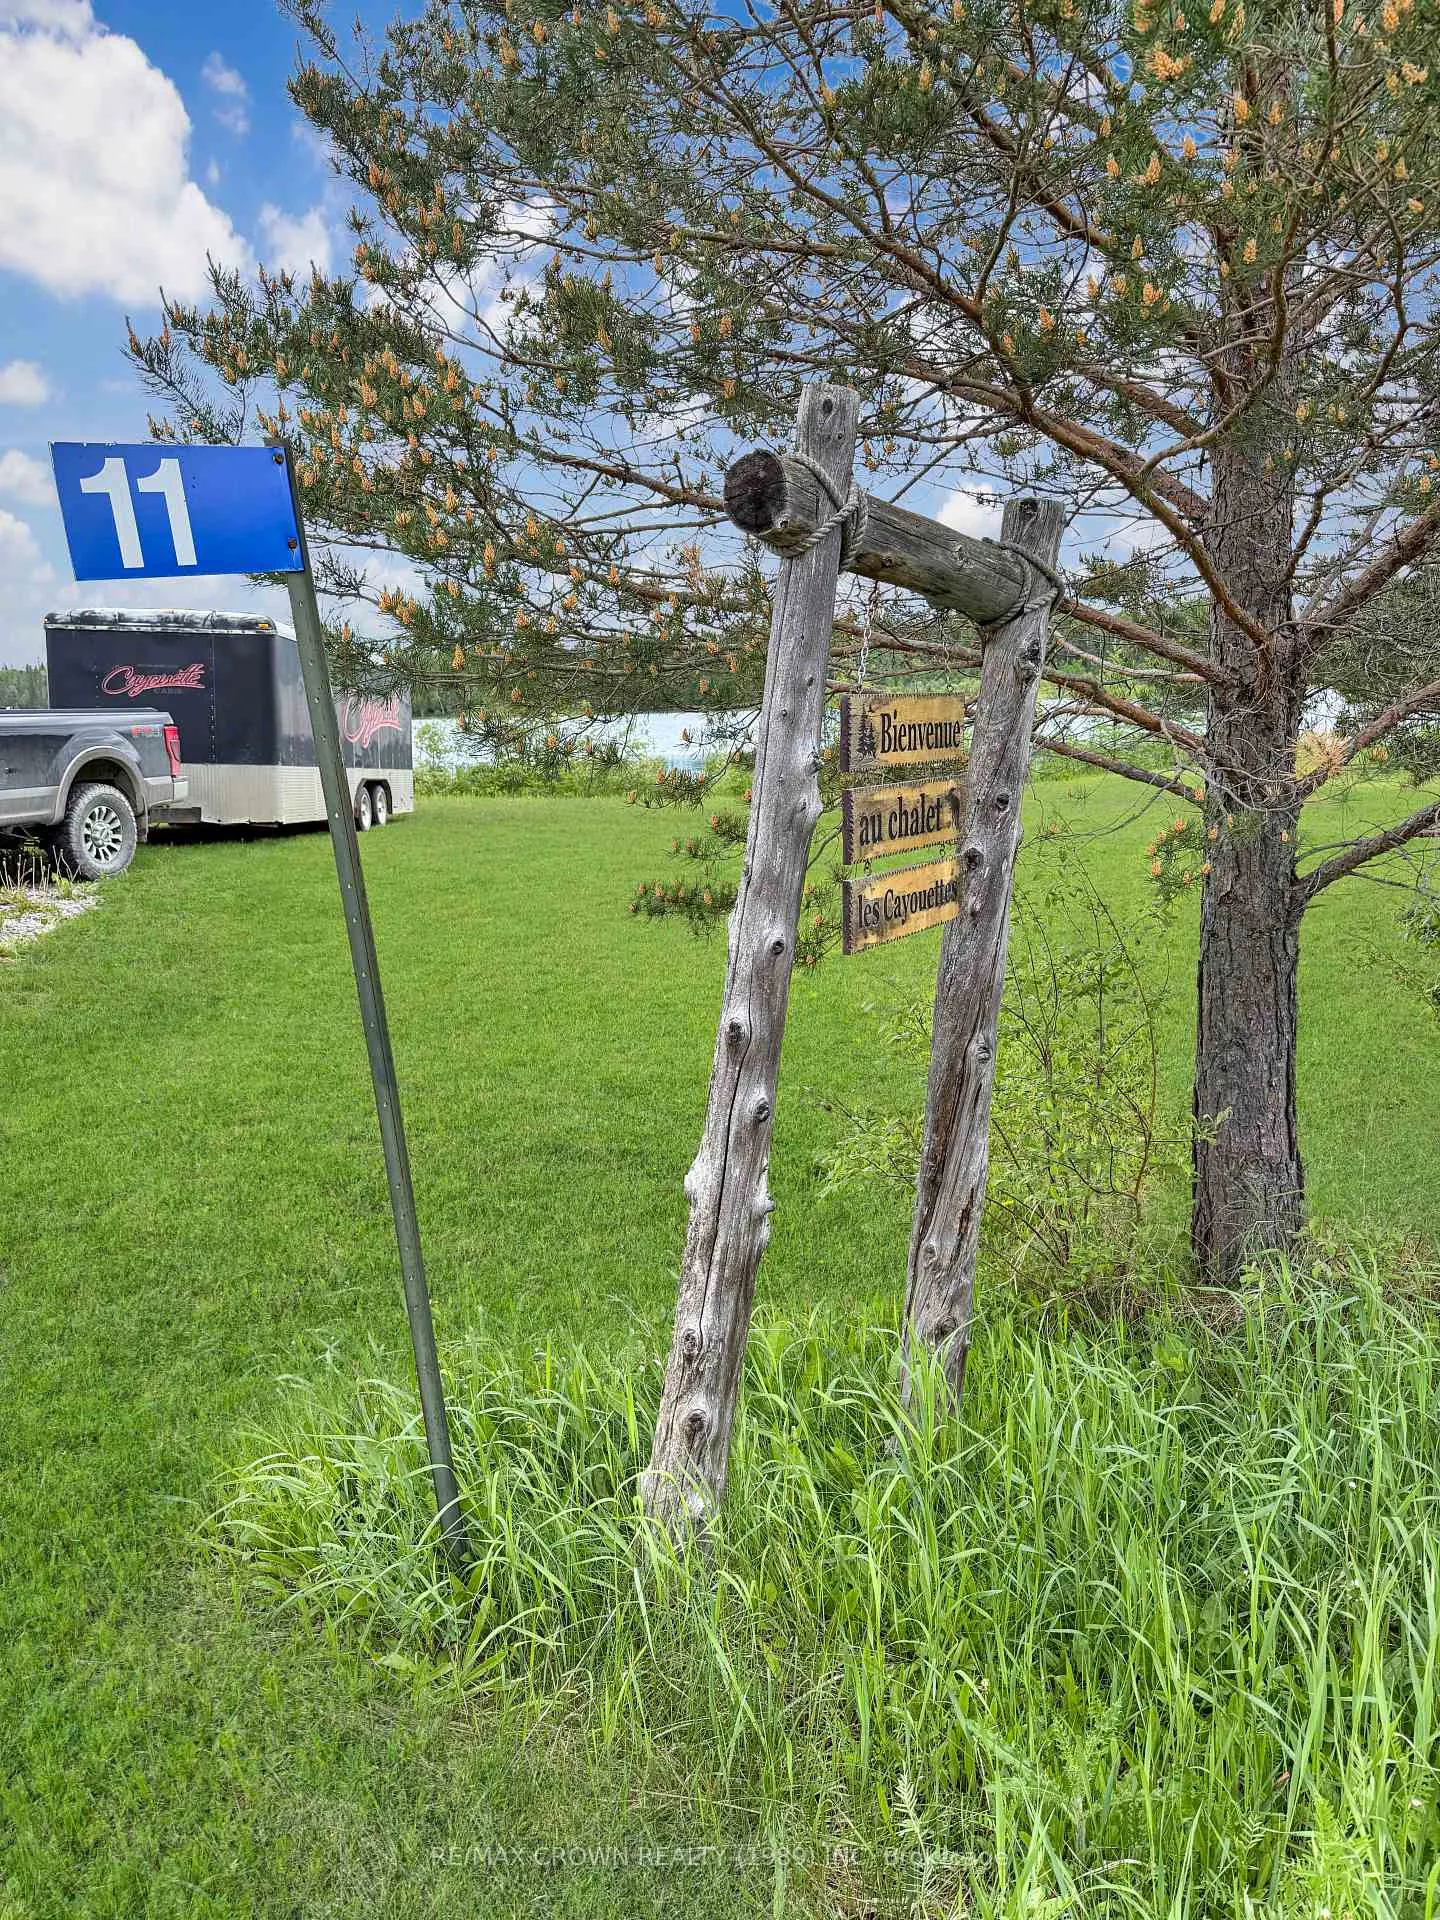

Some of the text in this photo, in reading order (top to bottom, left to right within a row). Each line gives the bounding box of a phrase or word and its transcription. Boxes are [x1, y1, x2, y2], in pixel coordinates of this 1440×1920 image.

[80, 457, 198, 569] 11
[880, 709, 960, 753] Bienvenue
[860, 793, 943, 845] au chalet
[858, 879, 957, 928] les Cayouettes
